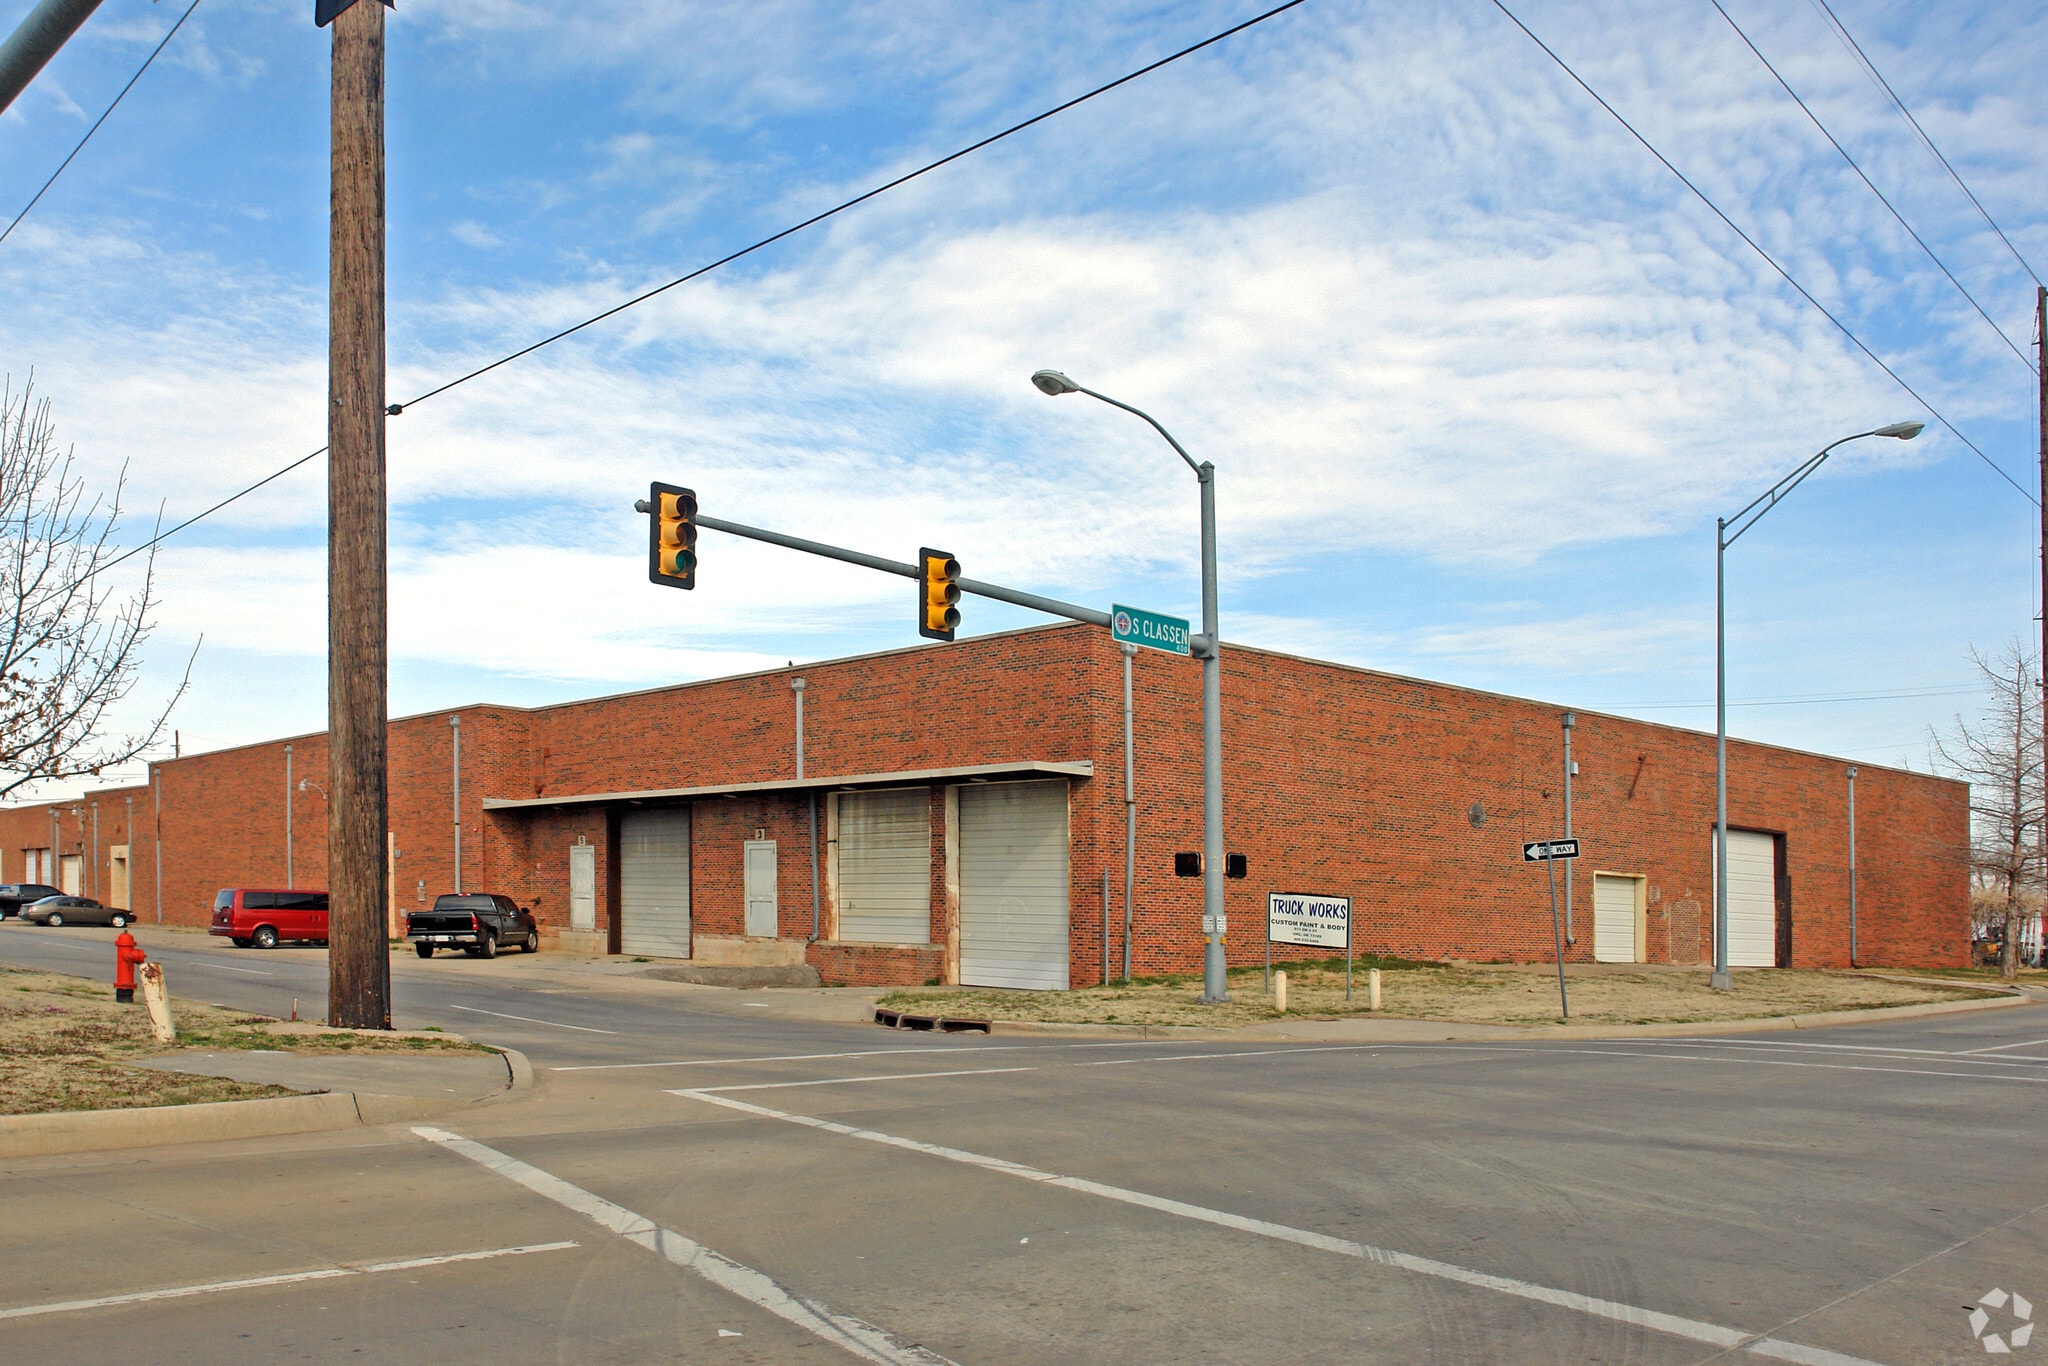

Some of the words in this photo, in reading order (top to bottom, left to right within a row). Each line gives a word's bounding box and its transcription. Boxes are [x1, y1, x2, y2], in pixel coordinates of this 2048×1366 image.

[1133, 617, 1139, 635] S
[1143, 620, 1188, 645] CLASSEN
[757, 830, 762, 839] 3
[1555, 845, 1572, 853] WAY
[1273, 899, 1304, 916] TRUCK
[1309, 902, 1346, 920] WORKS
[1271, 918, 1298, 926] CUSTOM
